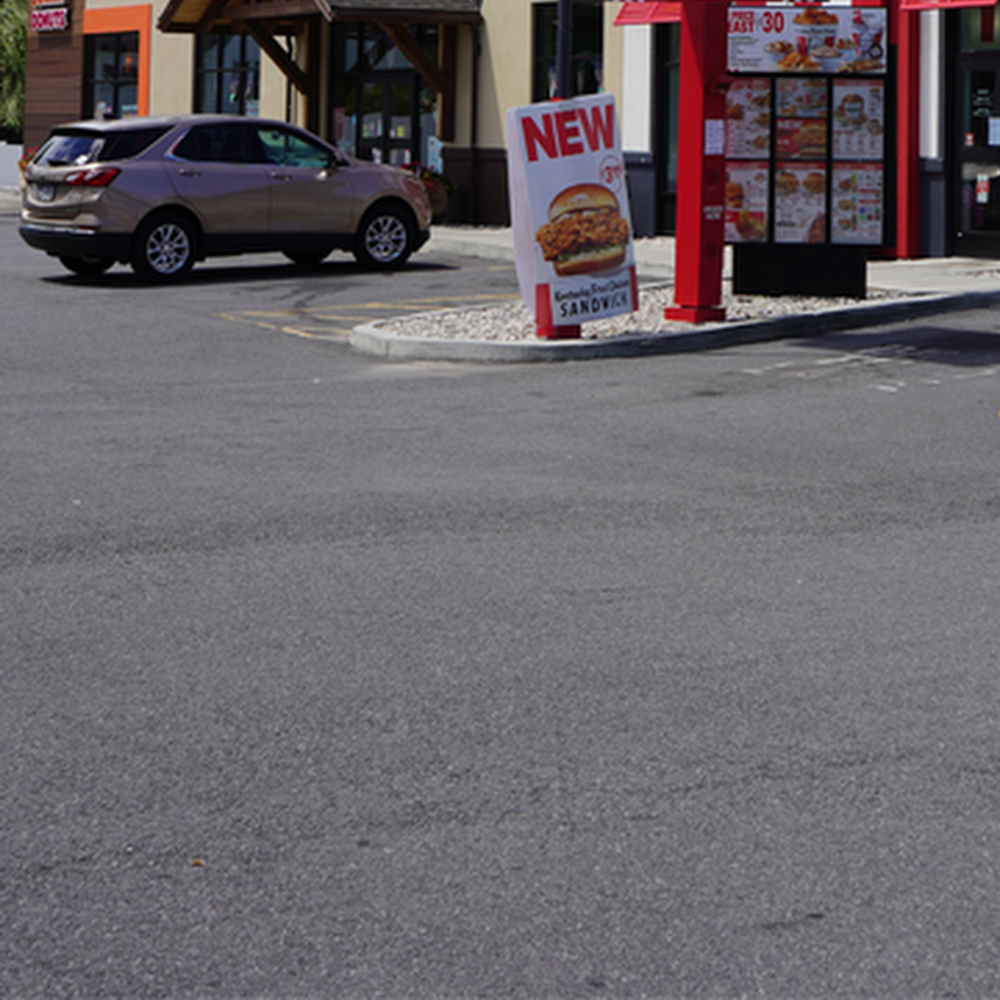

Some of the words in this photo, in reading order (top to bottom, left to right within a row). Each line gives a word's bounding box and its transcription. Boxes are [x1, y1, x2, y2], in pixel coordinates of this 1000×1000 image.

[30, 10, 66, 30] DONUTS
[521, 103, 615, 163] NEW
[561, 292, 627, 318] SANDWICH
